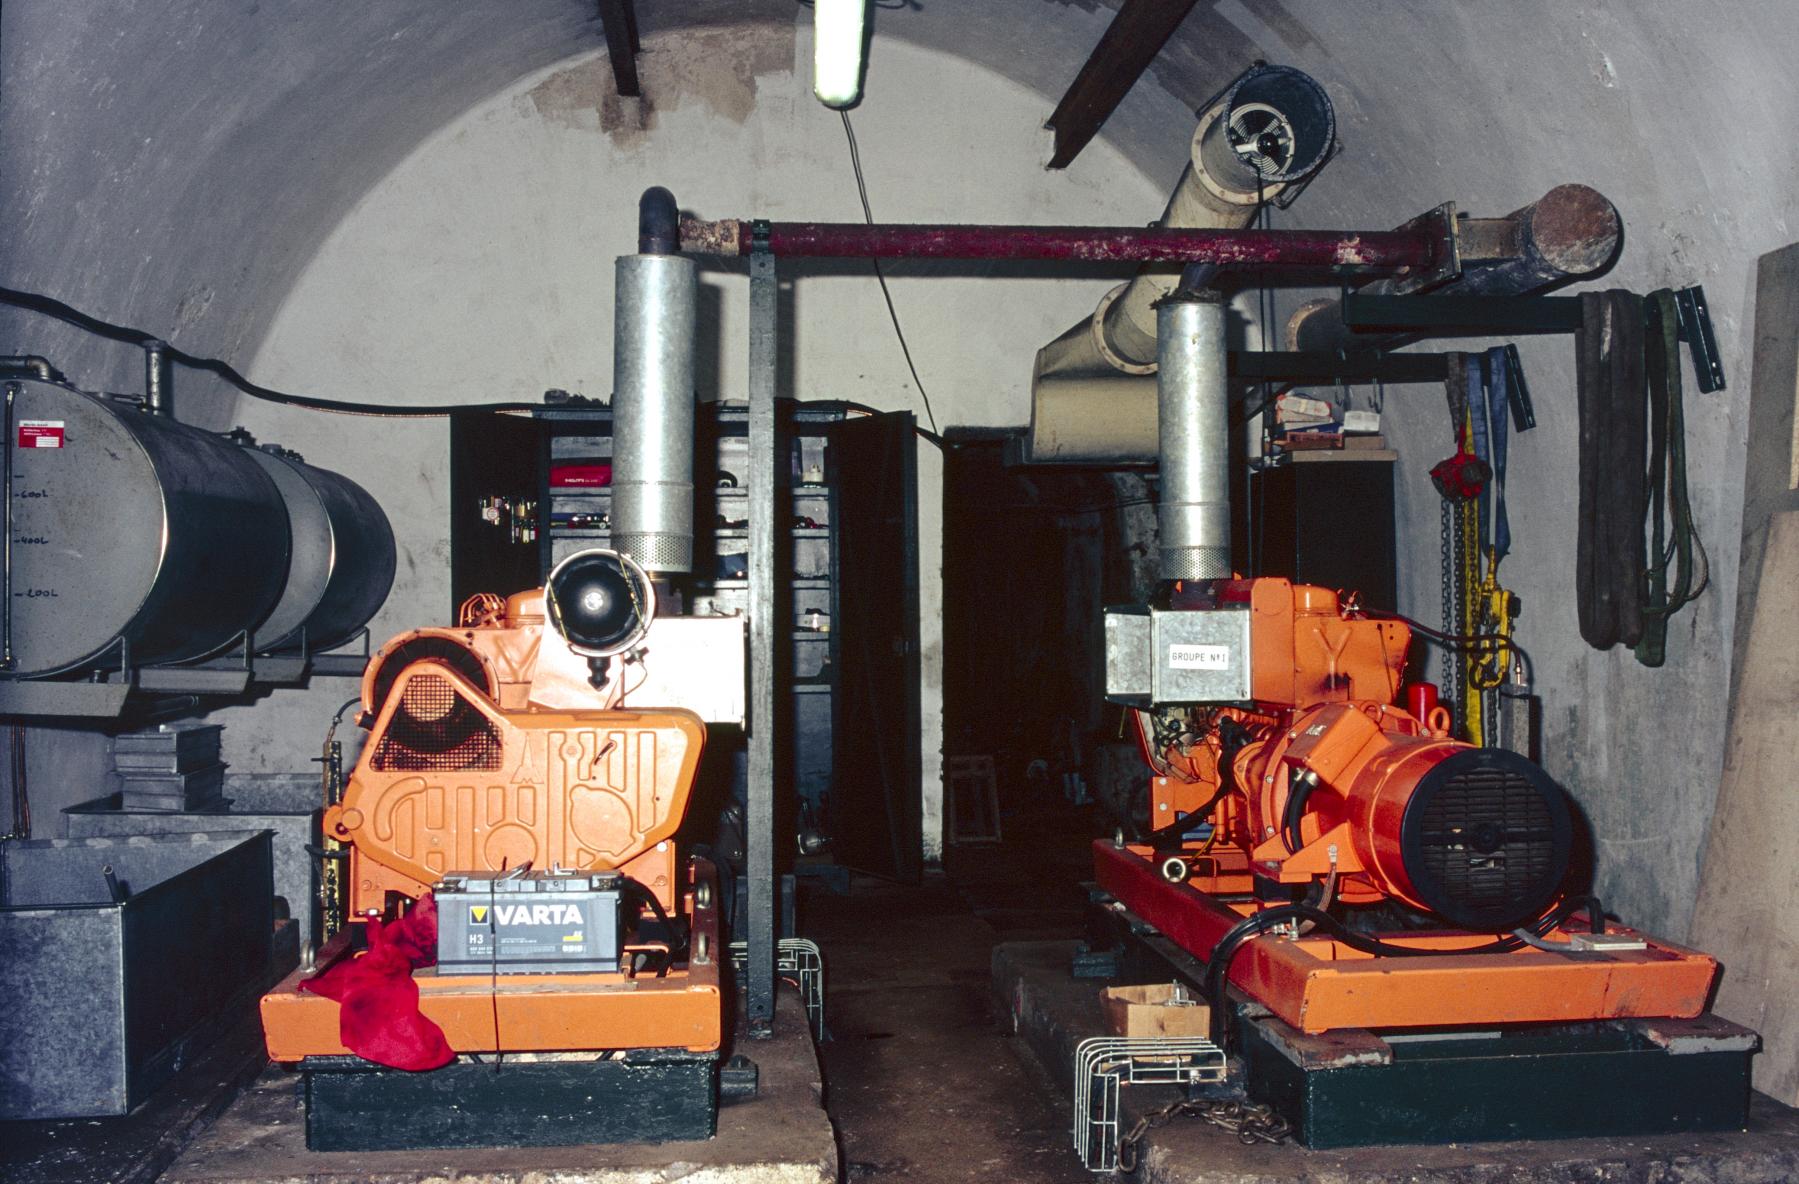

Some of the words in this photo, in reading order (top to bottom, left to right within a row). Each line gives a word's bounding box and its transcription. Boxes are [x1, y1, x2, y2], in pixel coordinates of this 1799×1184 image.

[1172, 652, 1205, 662] GROUPE
[494, 905, 584, 925] VARTA
[469, 934, 484, 945] H3
